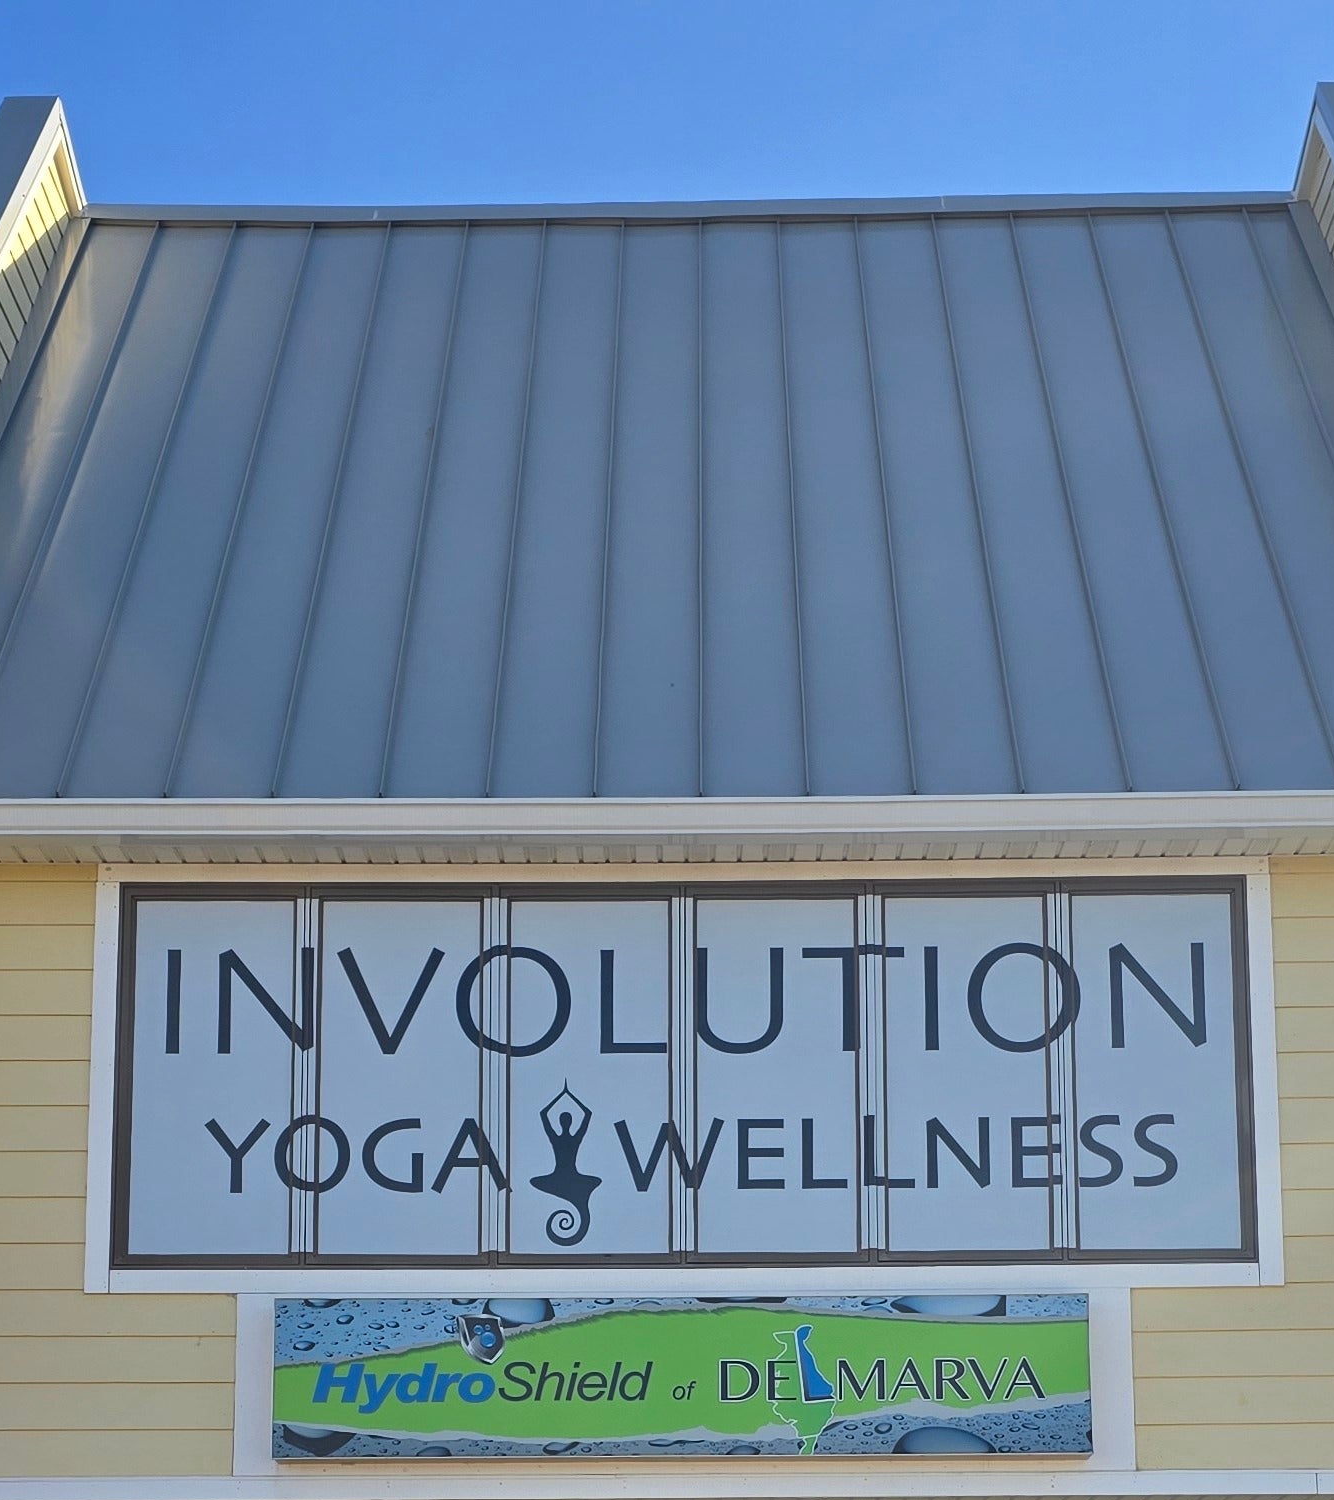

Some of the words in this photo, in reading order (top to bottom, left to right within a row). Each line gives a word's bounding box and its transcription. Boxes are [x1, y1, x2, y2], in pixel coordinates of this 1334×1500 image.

[165, 942, 1207, 1057] INVOLUTION
[204, 1116, 513, 1193] YOGA
[614, 1113, 1179, 1192] WELLNESS
[312, 1361, 654, 1414] HydroShield
[672, 1380, 697, 1403] of
[719, 1344, 1047, 1402] DELMARVA
